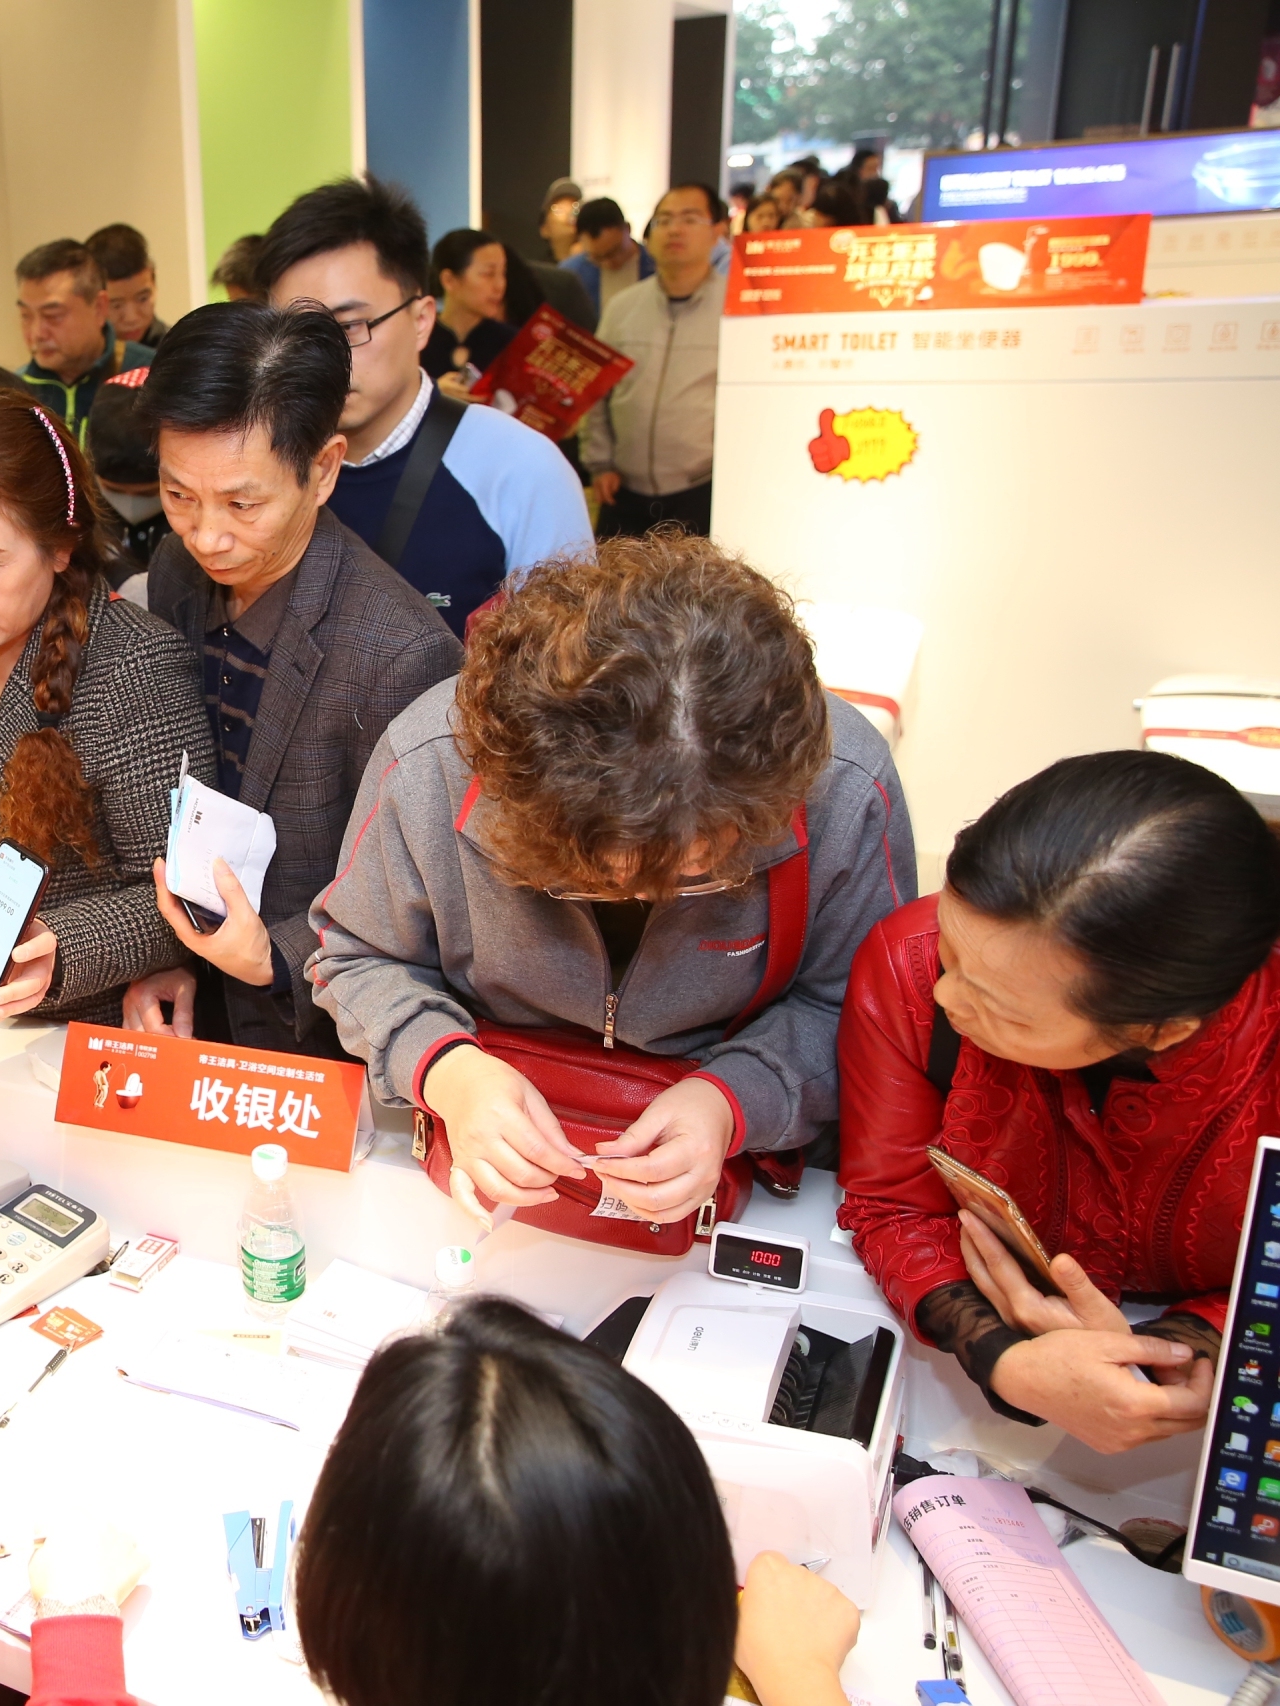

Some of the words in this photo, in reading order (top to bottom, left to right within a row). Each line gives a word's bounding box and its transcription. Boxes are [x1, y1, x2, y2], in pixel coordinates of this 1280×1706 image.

[772, 333, 828, 352] SMART
[841, 330, 898, 351] TOILET
[190, 1076, 322, 1139] 收银处
[750, 1250, 781, 1267] 1000
[11, 1262, 24, 1274] 3
[1238, 1343, 1274, 1355] Experience
